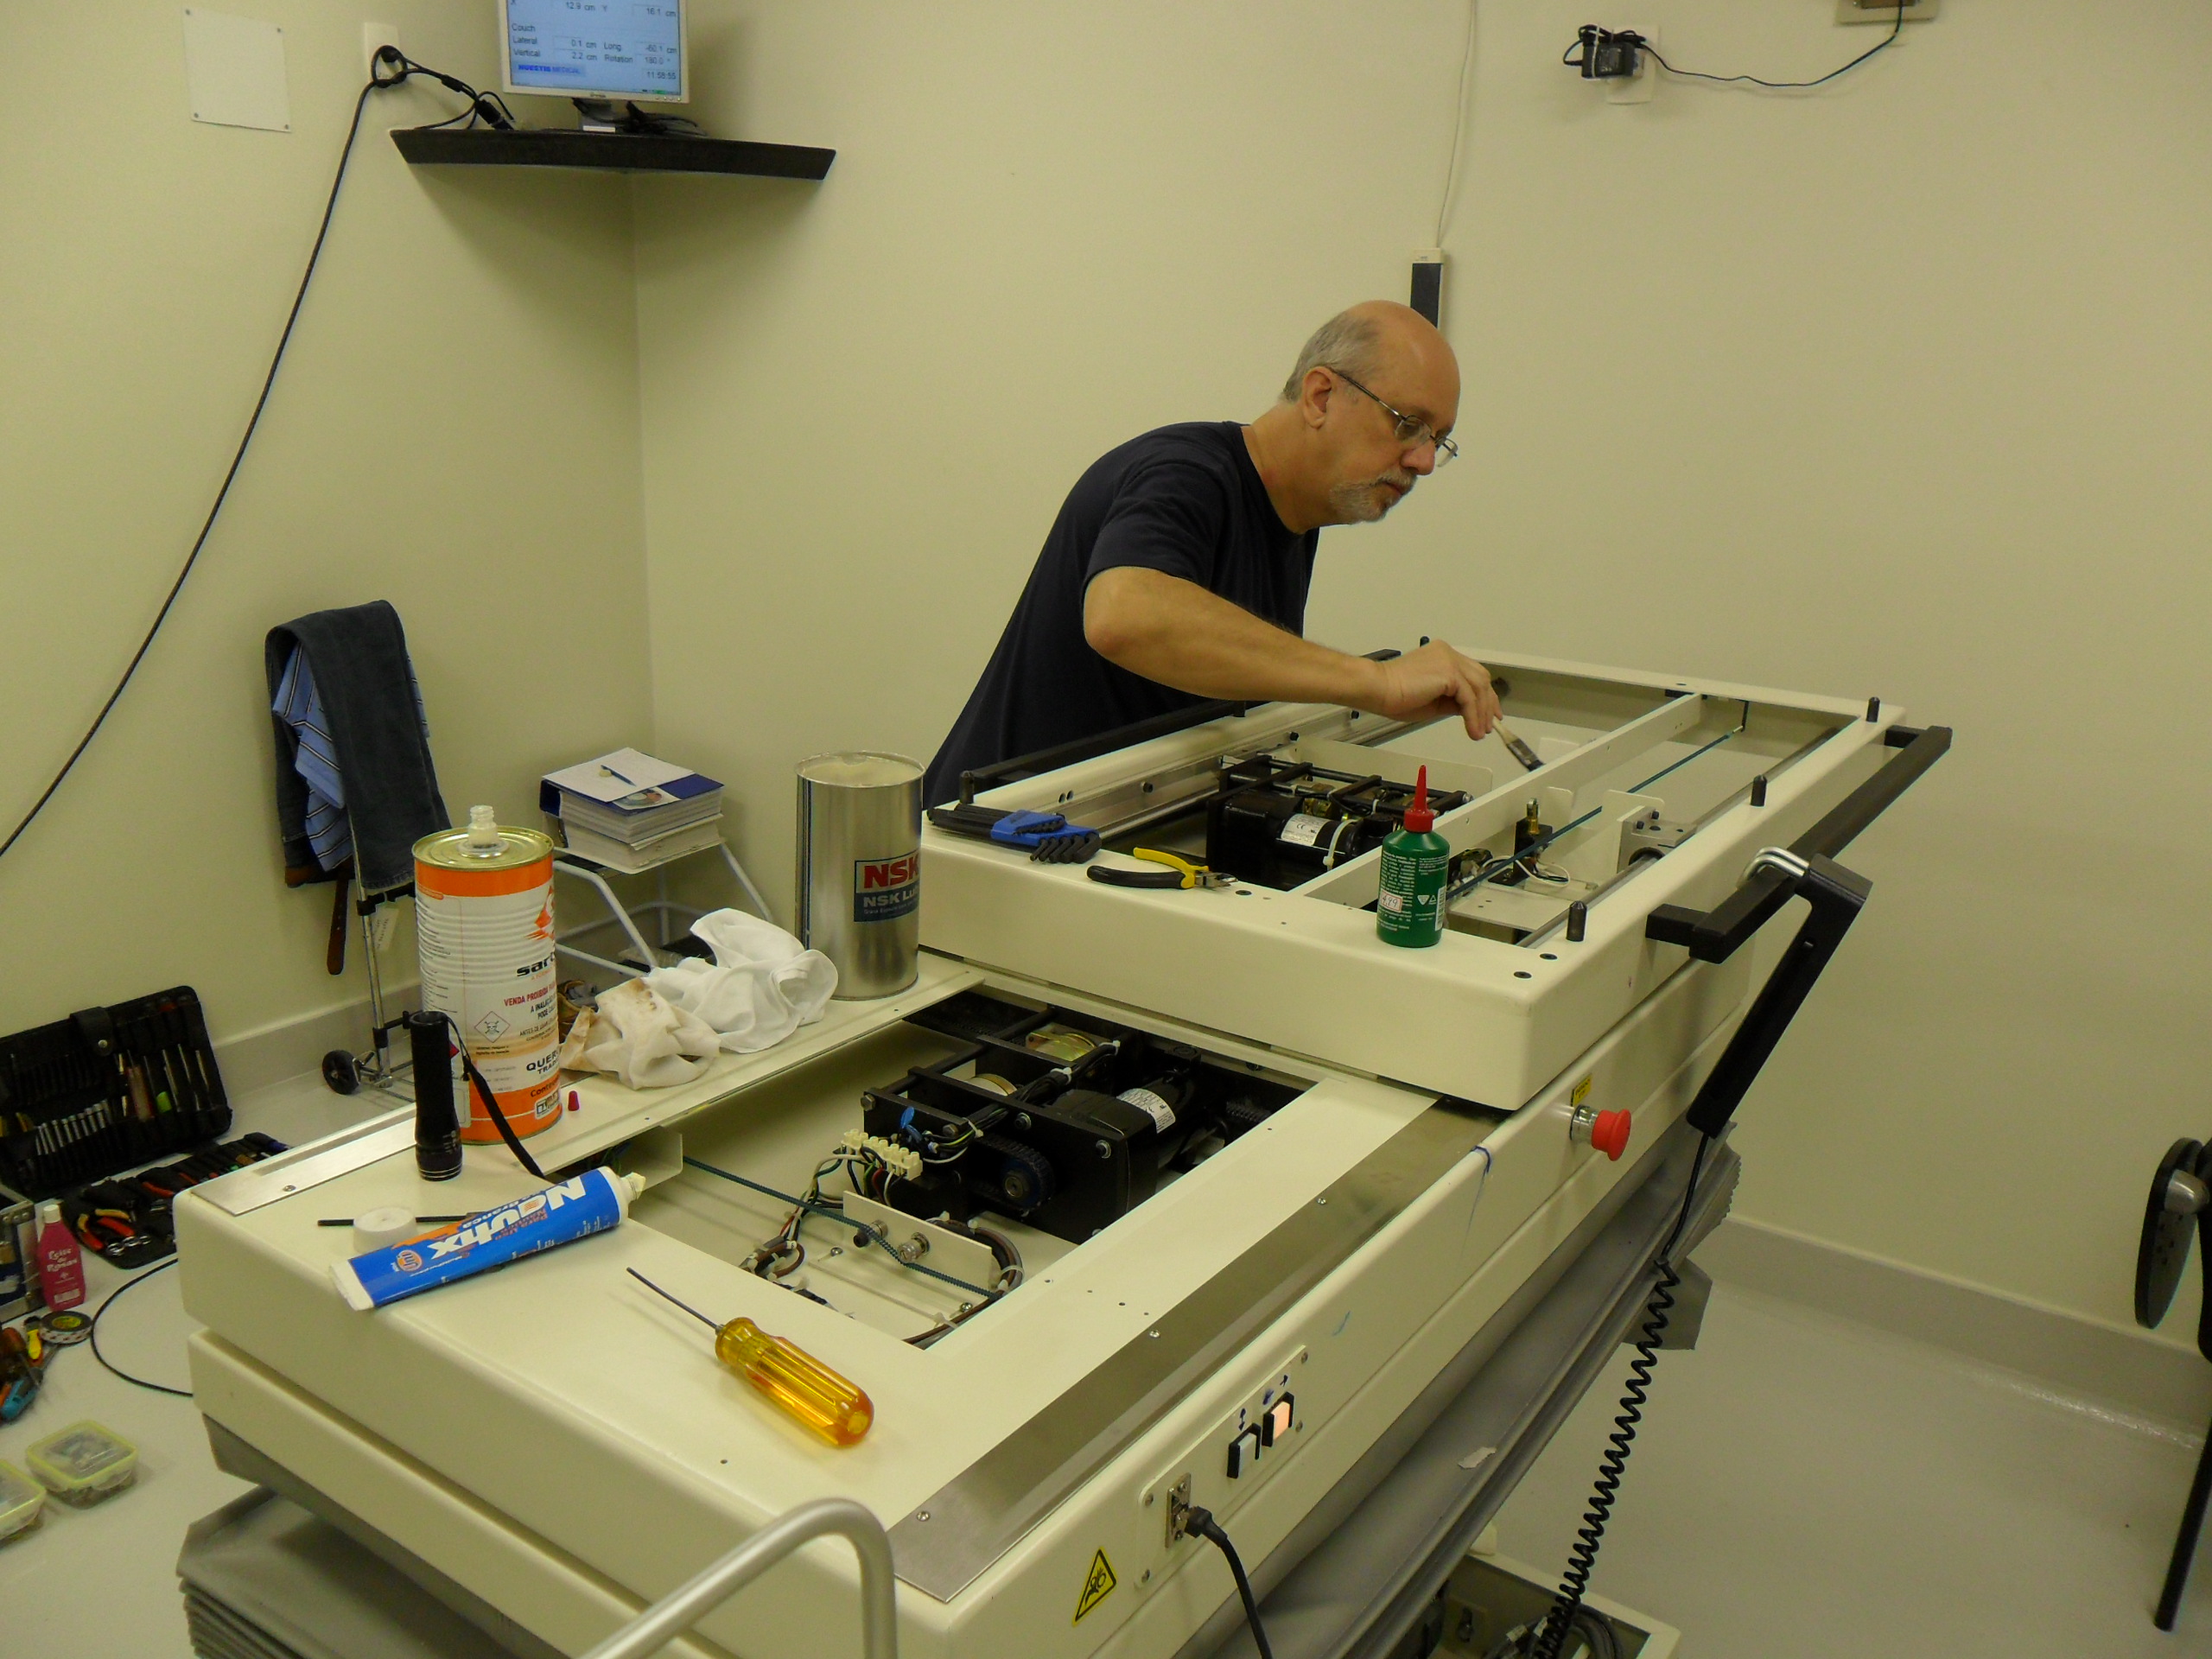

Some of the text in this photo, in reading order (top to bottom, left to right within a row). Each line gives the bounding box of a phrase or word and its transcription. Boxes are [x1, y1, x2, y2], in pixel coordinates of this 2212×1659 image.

[512, 22, 536, 32] Couch
[512, 35, 537, 45] Lateral
[604, 41, 621, 52] Long
[513, 48, 540, 57] Vertical
[604, 54, 633, 63] Rotation
[864, 853, 918, 888] NSK
[863, 893, 899, 907] NSK
[504, 995, 525, 1007] VENDA
